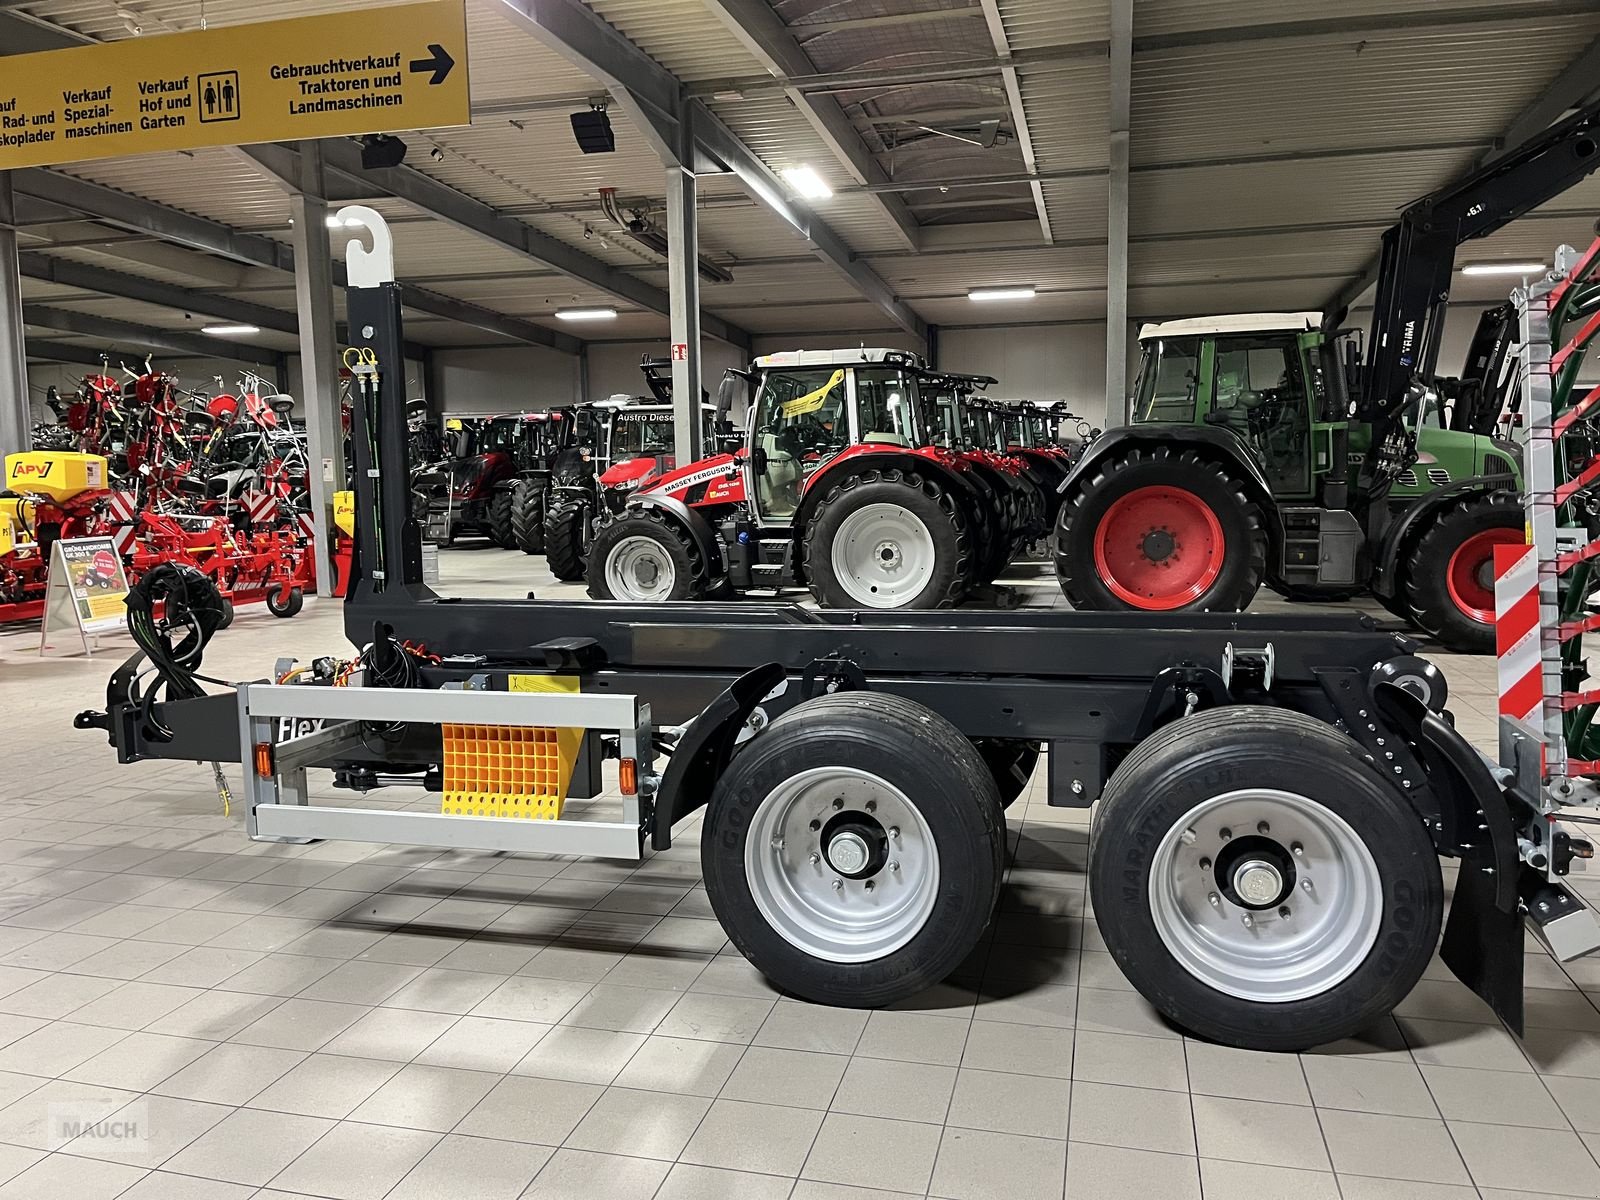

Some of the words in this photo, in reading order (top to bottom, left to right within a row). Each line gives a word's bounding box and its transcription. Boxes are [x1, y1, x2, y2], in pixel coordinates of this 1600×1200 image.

[270, 53, 401, 79] Gebrauchtverkauf
[138, 76, 189, 95] Verkauf
[299, 78, 369, 95] Traktoren
[374, 72, 401, 89] und
[63, 86, 111, 104] Verkauf
[139, 98, 162, 112] Hof
[167, 94, 192, 109] und
[289, 93, 402, 115] Landmaschinen
[3, 114, 29, 128] Rad-
[32, 110, 55, 125] und
[64, 104, 114, 124] Spezial-
[140, 115, 185, 131] Garten
[65, 121, 133, 139] maschinen
[1402, 320, 1415, 354] TRIMA
[617, 411, 647, 422] Austro
[649, 411, 675, 422] Diese
[664, 477, 692, 493] MASSEY
[693, 464, 731, 482] FERGUSON
[278, 716, 326, 742] Flex
